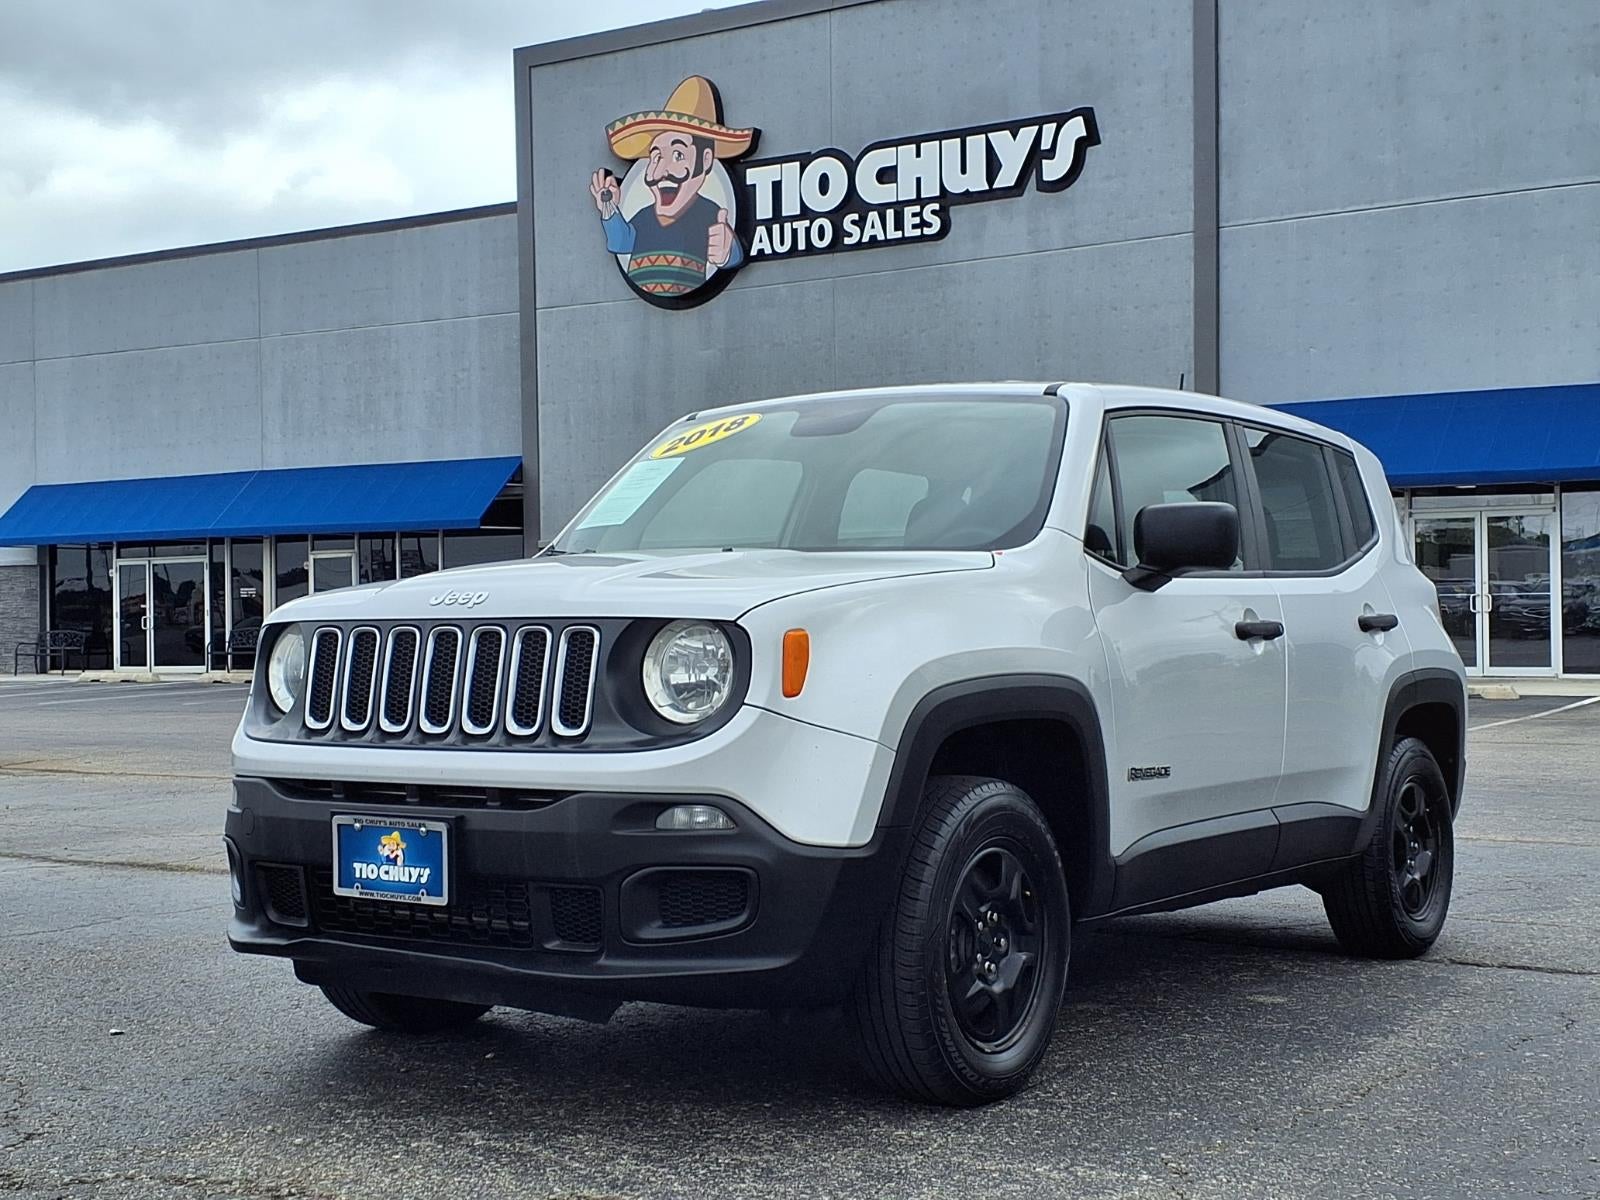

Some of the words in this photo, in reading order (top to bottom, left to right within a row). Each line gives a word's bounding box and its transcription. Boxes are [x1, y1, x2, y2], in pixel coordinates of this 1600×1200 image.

[746, 156, 848, 220] TIO
[855, 115, 1087, 204] CHUY'S
[750, 217, 833, 256] AUTO
[843, 202, 941, 245] SALES
[661, 416, 750, 456] 2018
[429, 589, 489, 609] Jeep
[1128, 766, 1171, 782] RENEGADE
[388, 820, 405, 828] AUTO
[353, 862, 378, 879] TIO
[379, 865, 430, 883] CHUY'S
[359, 891, 422, 901] WWW.TIOCHUYS.COM
